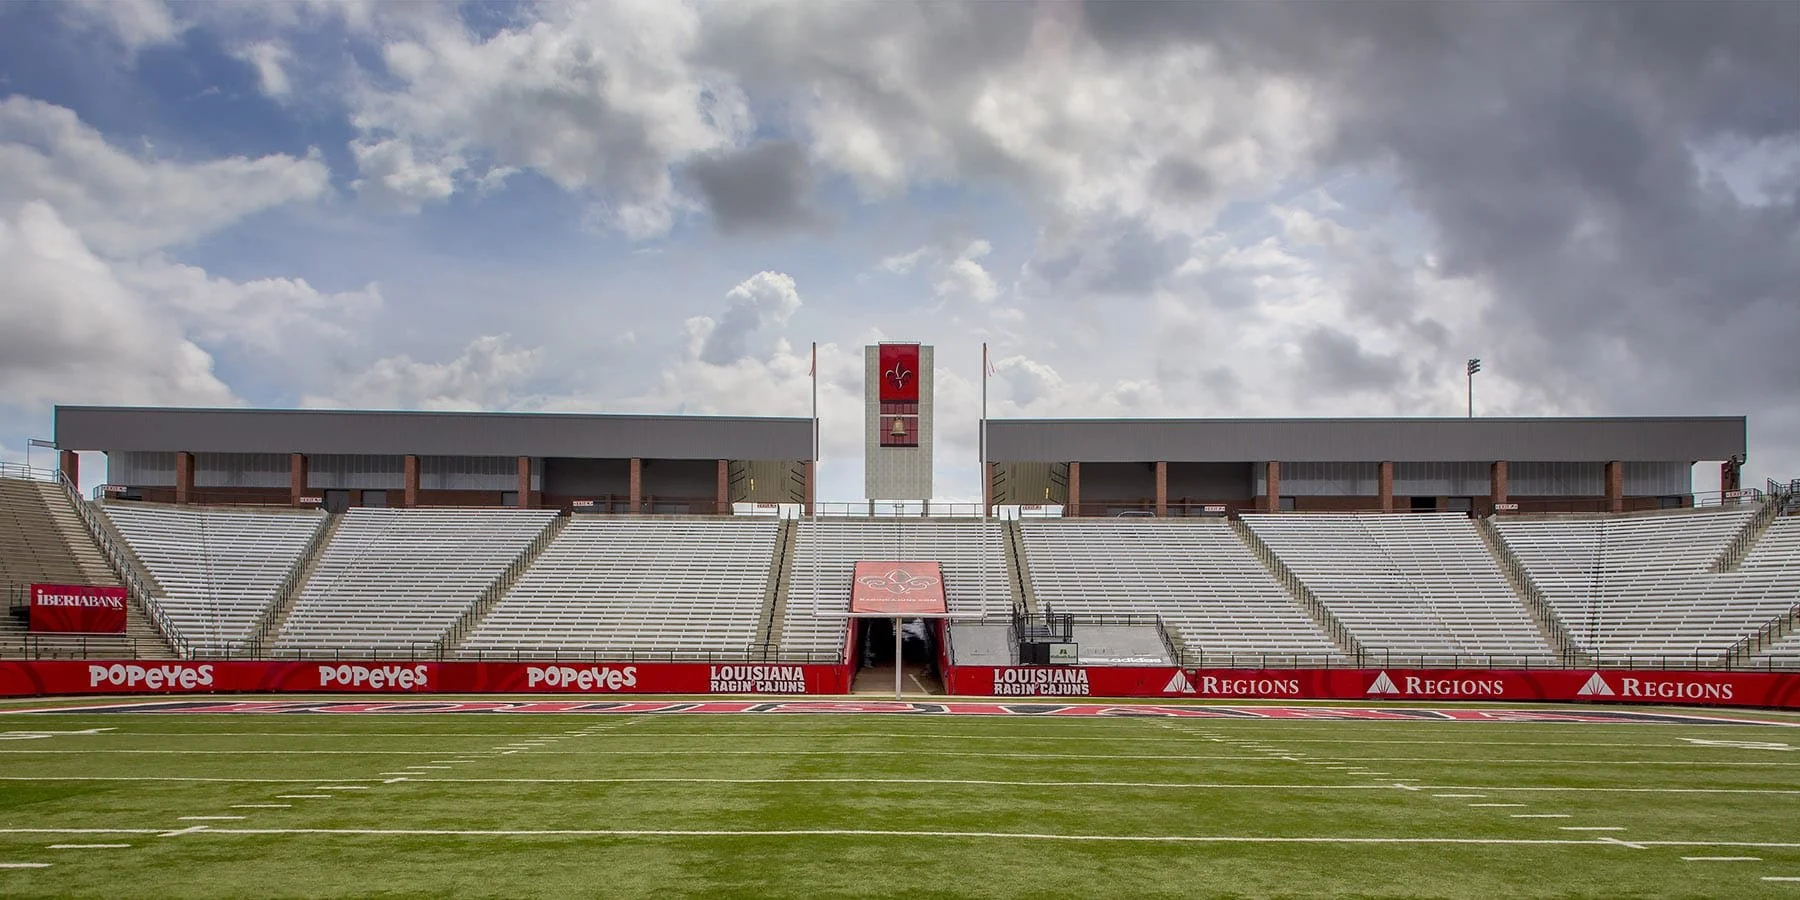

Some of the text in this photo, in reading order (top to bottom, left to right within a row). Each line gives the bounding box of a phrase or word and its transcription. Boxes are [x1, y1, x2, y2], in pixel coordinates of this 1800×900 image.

[711, 666, 804, 680] LOUISIANA
[994, 669, 1088, 683] LOUISIANA
[756, 681, 805, 692] CAJUNS
[1039, 683, 1089, 695] CAJUNS
[1203, 676, 1298, 695] REGIONS
[1405, 676, 1503, 695] REGIONS
[1622, 678, 1733, 699] REGIONS
